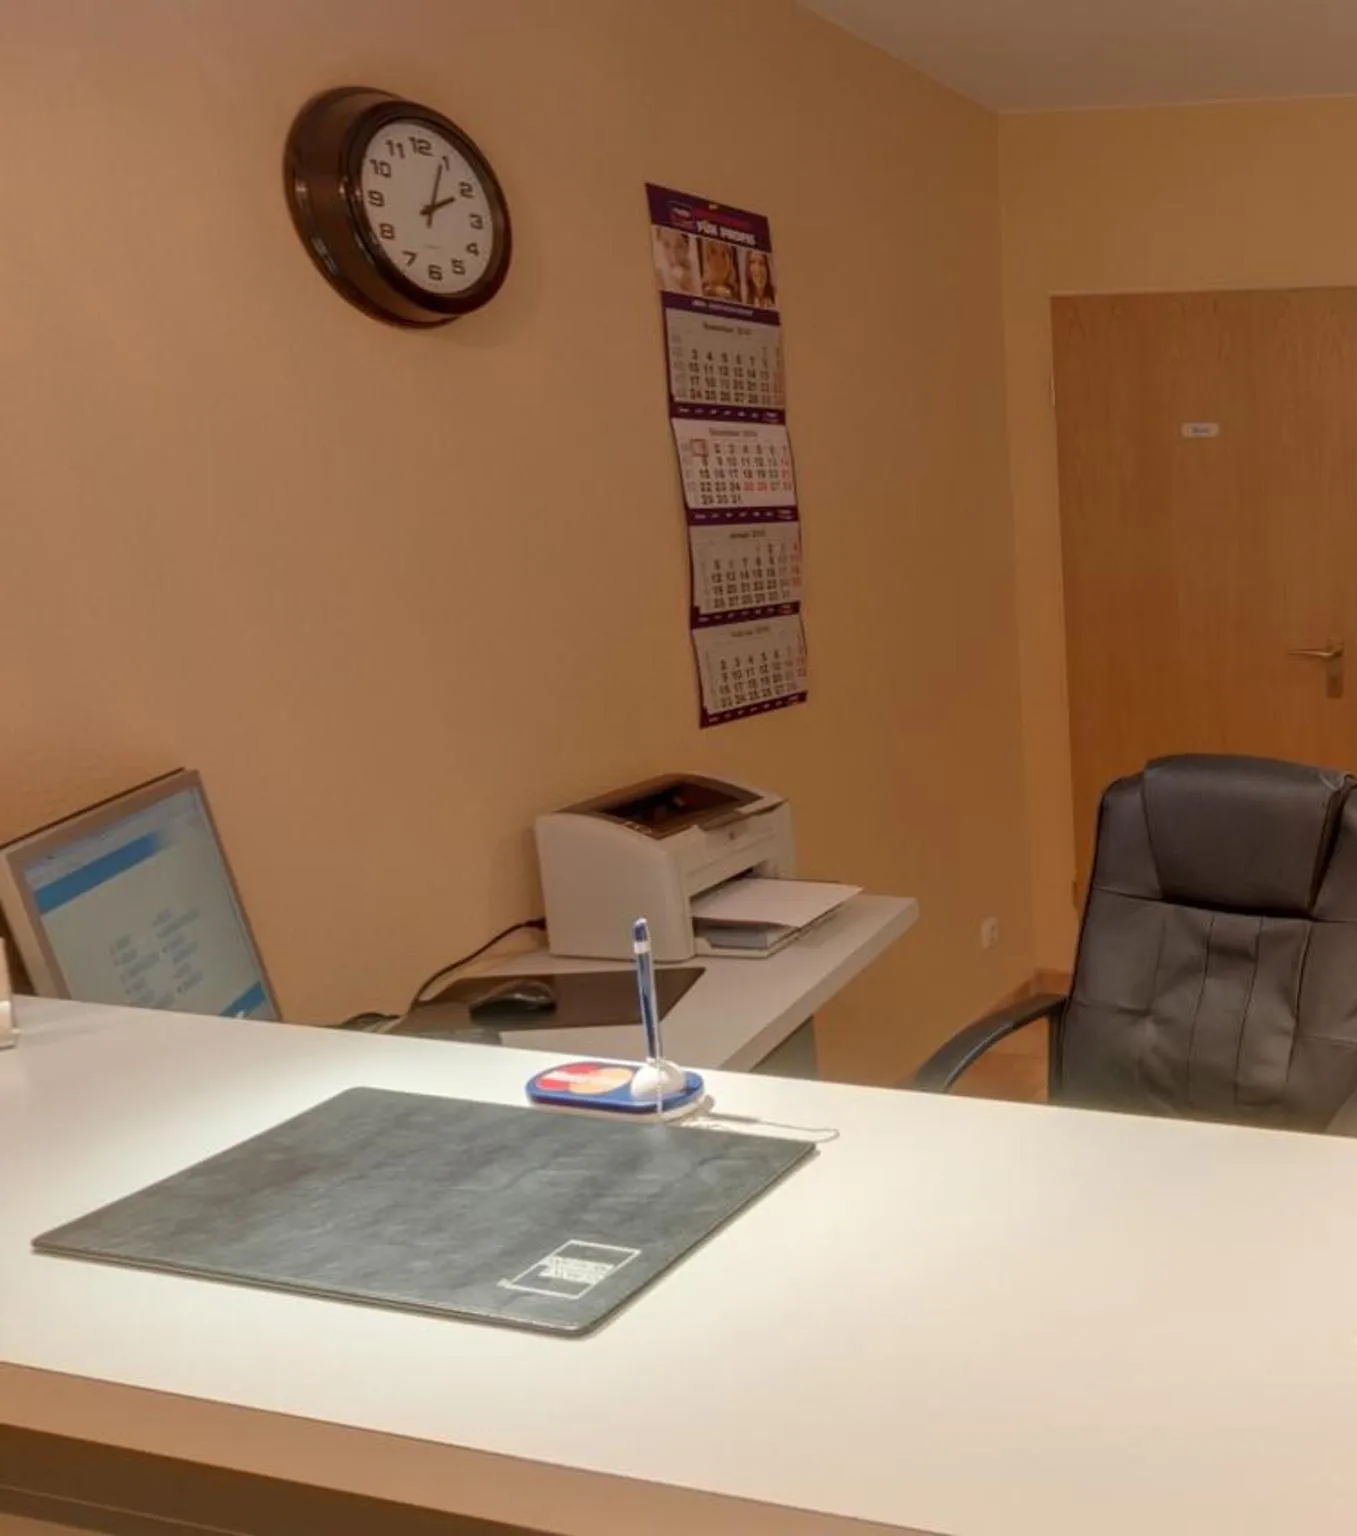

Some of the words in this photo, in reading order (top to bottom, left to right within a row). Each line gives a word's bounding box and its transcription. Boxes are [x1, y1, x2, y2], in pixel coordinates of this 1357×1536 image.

[386, 140, 405, 159] 11
[408, 137, 434, 157] 12
[370, 159, 392, 178] 10
[441, 155, 450, 172] 1
[368, 190, 385, 207] 9
[458, 181, 475, 199] 2
[469, 213, 483, 230] 3
[379, 223, 396, 241] 8
[466, 242, 480, 256] 4
[402, 251, 417, 267] 7
[451, 258, 466, 276] 5
[428, 264, 443, 281] 6
